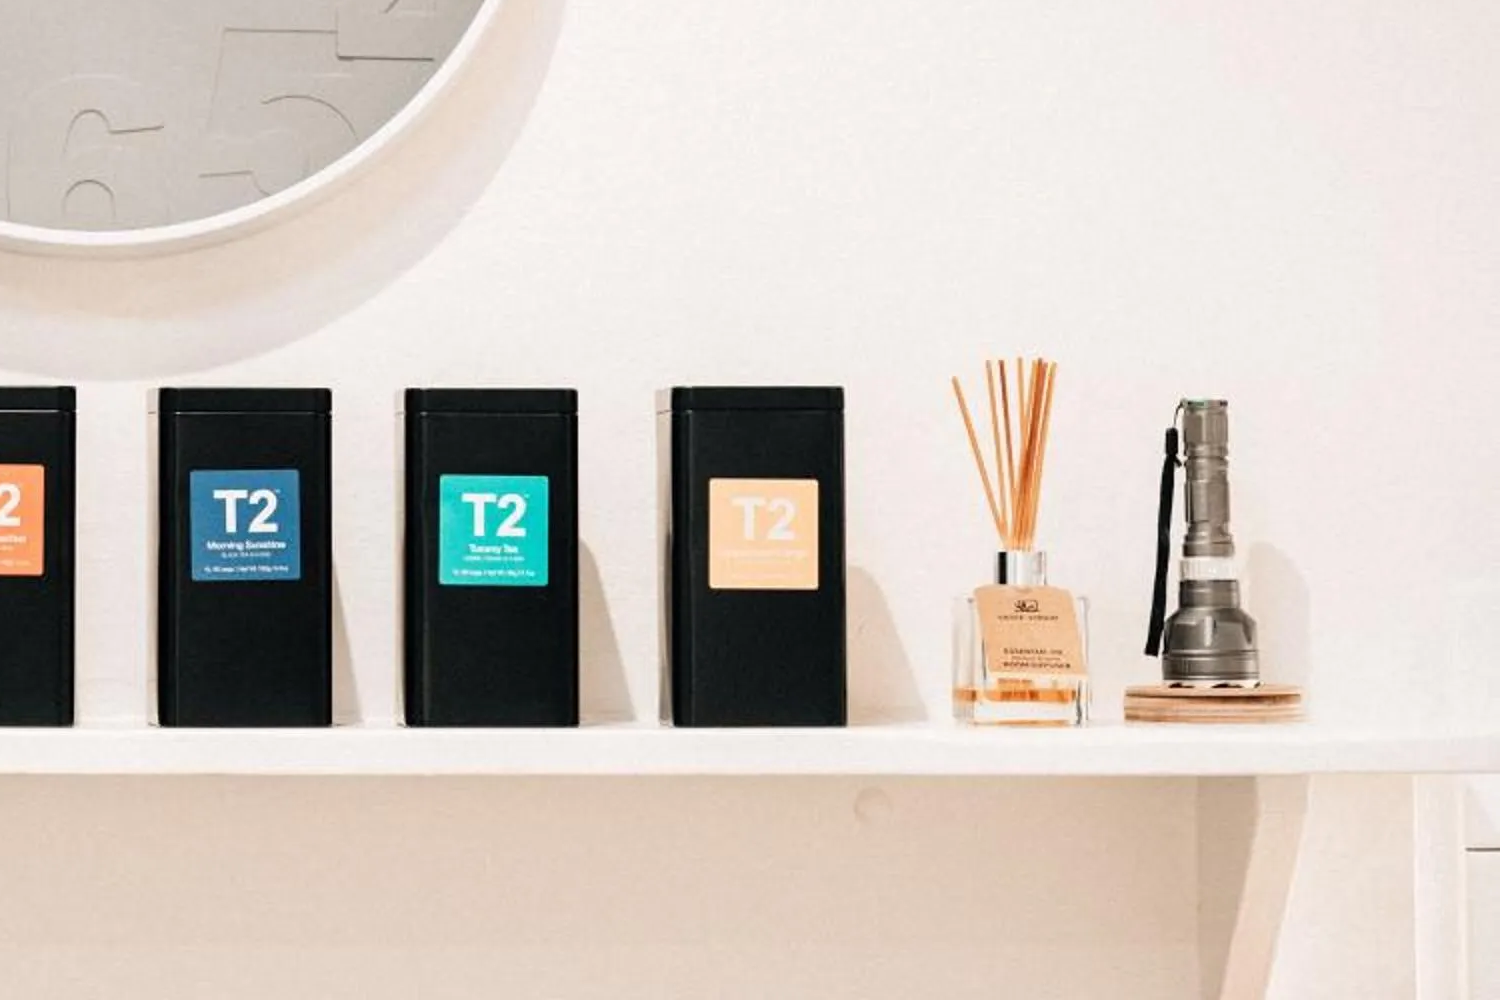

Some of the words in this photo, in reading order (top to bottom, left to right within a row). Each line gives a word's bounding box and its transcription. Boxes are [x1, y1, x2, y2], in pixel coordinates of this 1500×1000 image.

[213, 489, 278, 533] T2
[461, 493, 527, 537] T2
[730, 496, 796, 541] T2
[206, 540, 244, 551] Morning
